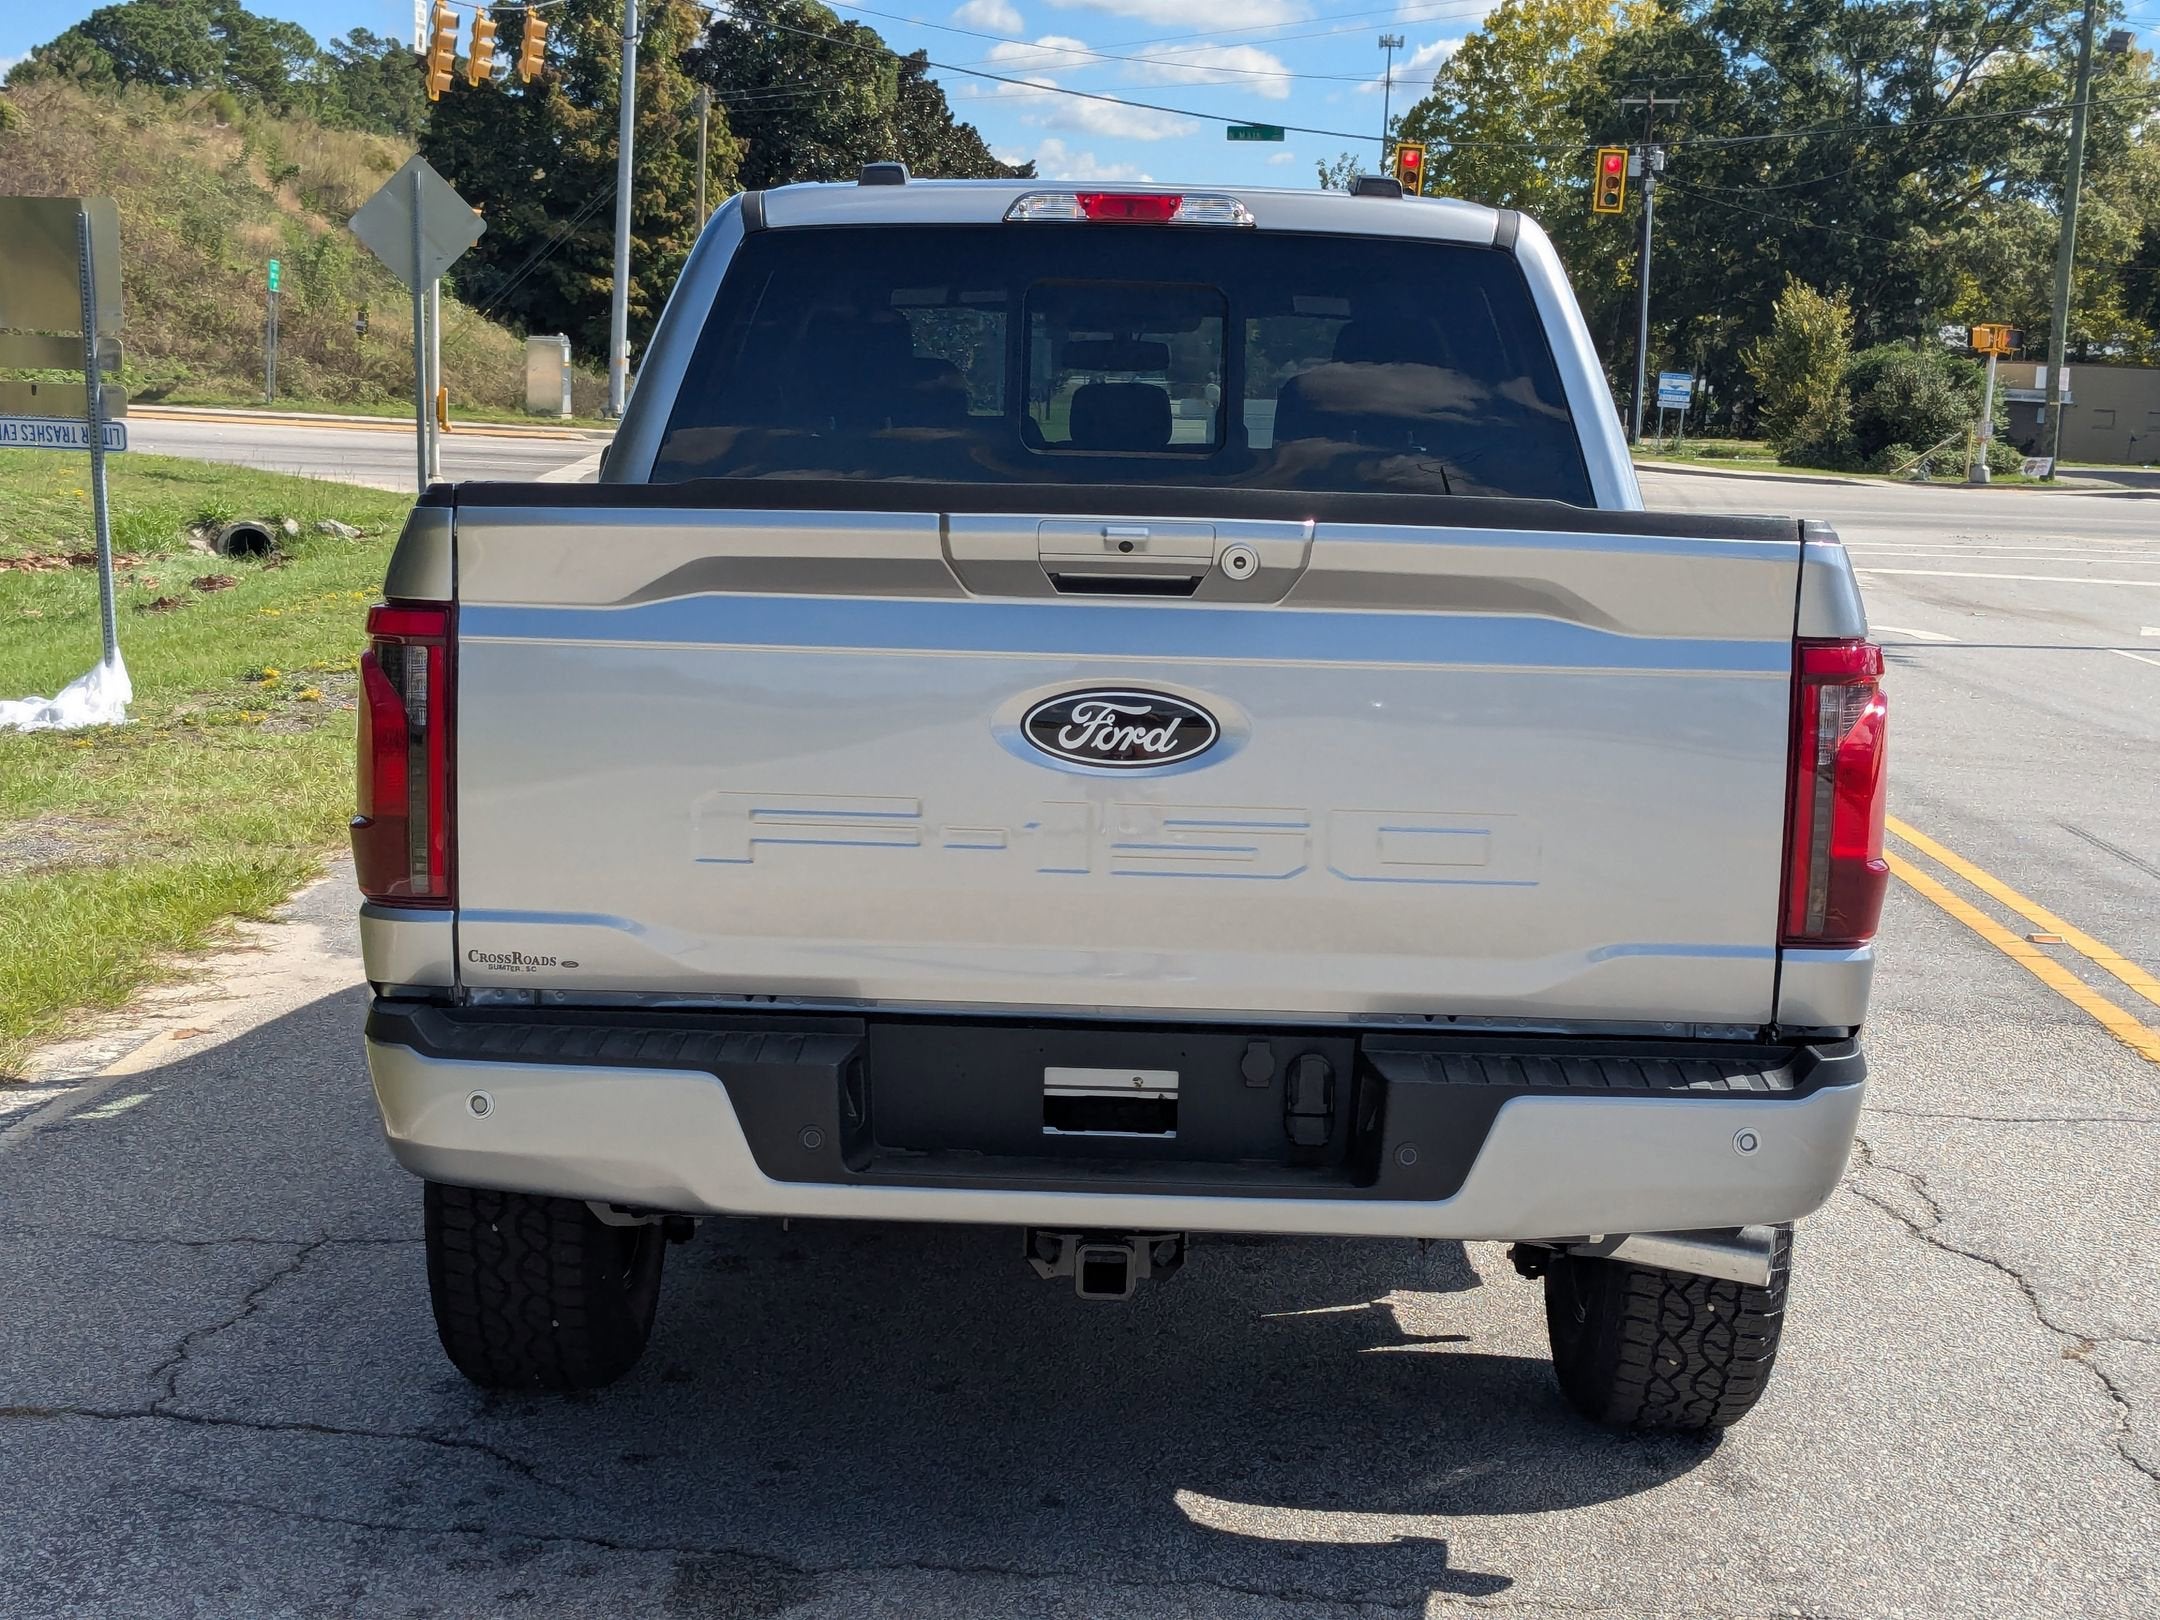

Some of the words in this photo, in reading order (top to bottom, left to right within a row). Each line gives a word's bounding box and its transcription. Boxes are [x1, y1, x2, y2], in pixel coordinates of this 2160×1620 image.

[0, 423, 17, 441] EV
[21, 424, 79, 443] TRASHES
[81, 426, 121, 445] LITR
[1058, 701, 1182, 753] Ford
[692, 790, 1541, 886] F-150
